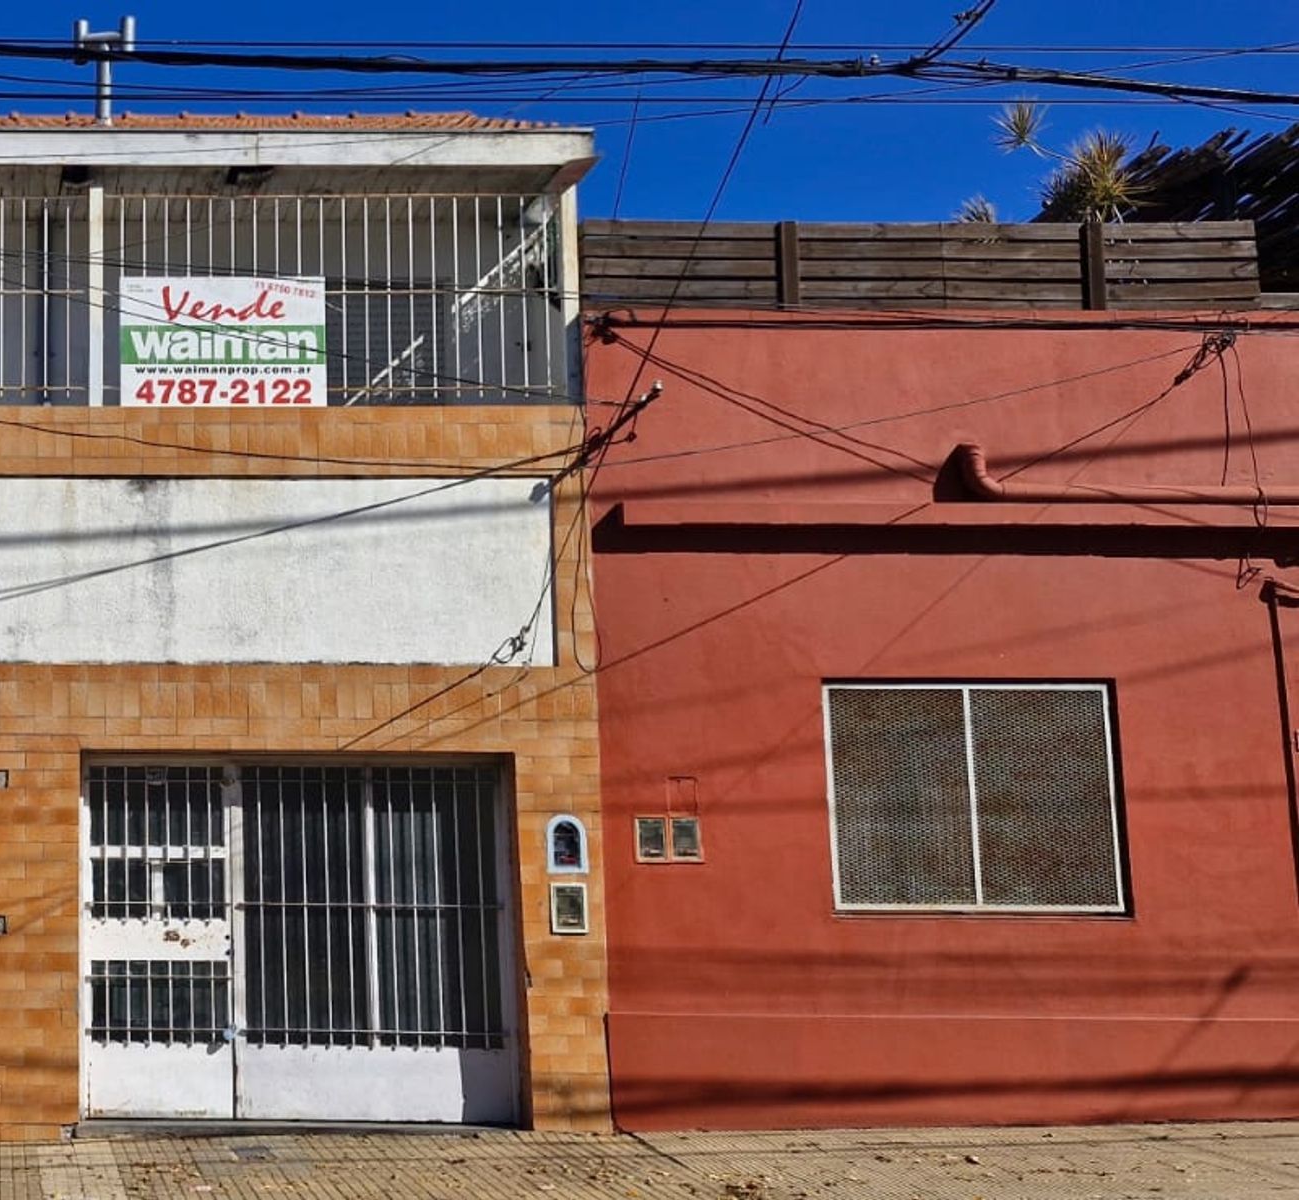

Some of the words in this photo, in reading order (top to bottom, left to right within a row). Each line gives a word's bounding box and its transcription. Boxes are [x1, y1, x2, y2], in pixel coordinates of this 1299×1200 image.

[162, 285, 286, 321] Vende
[130, 329, 318, 361] waiman
[135, 365, 311, 376] www.waimanprop.com.ar
[135, 378, 312, 405] 4787-2122
